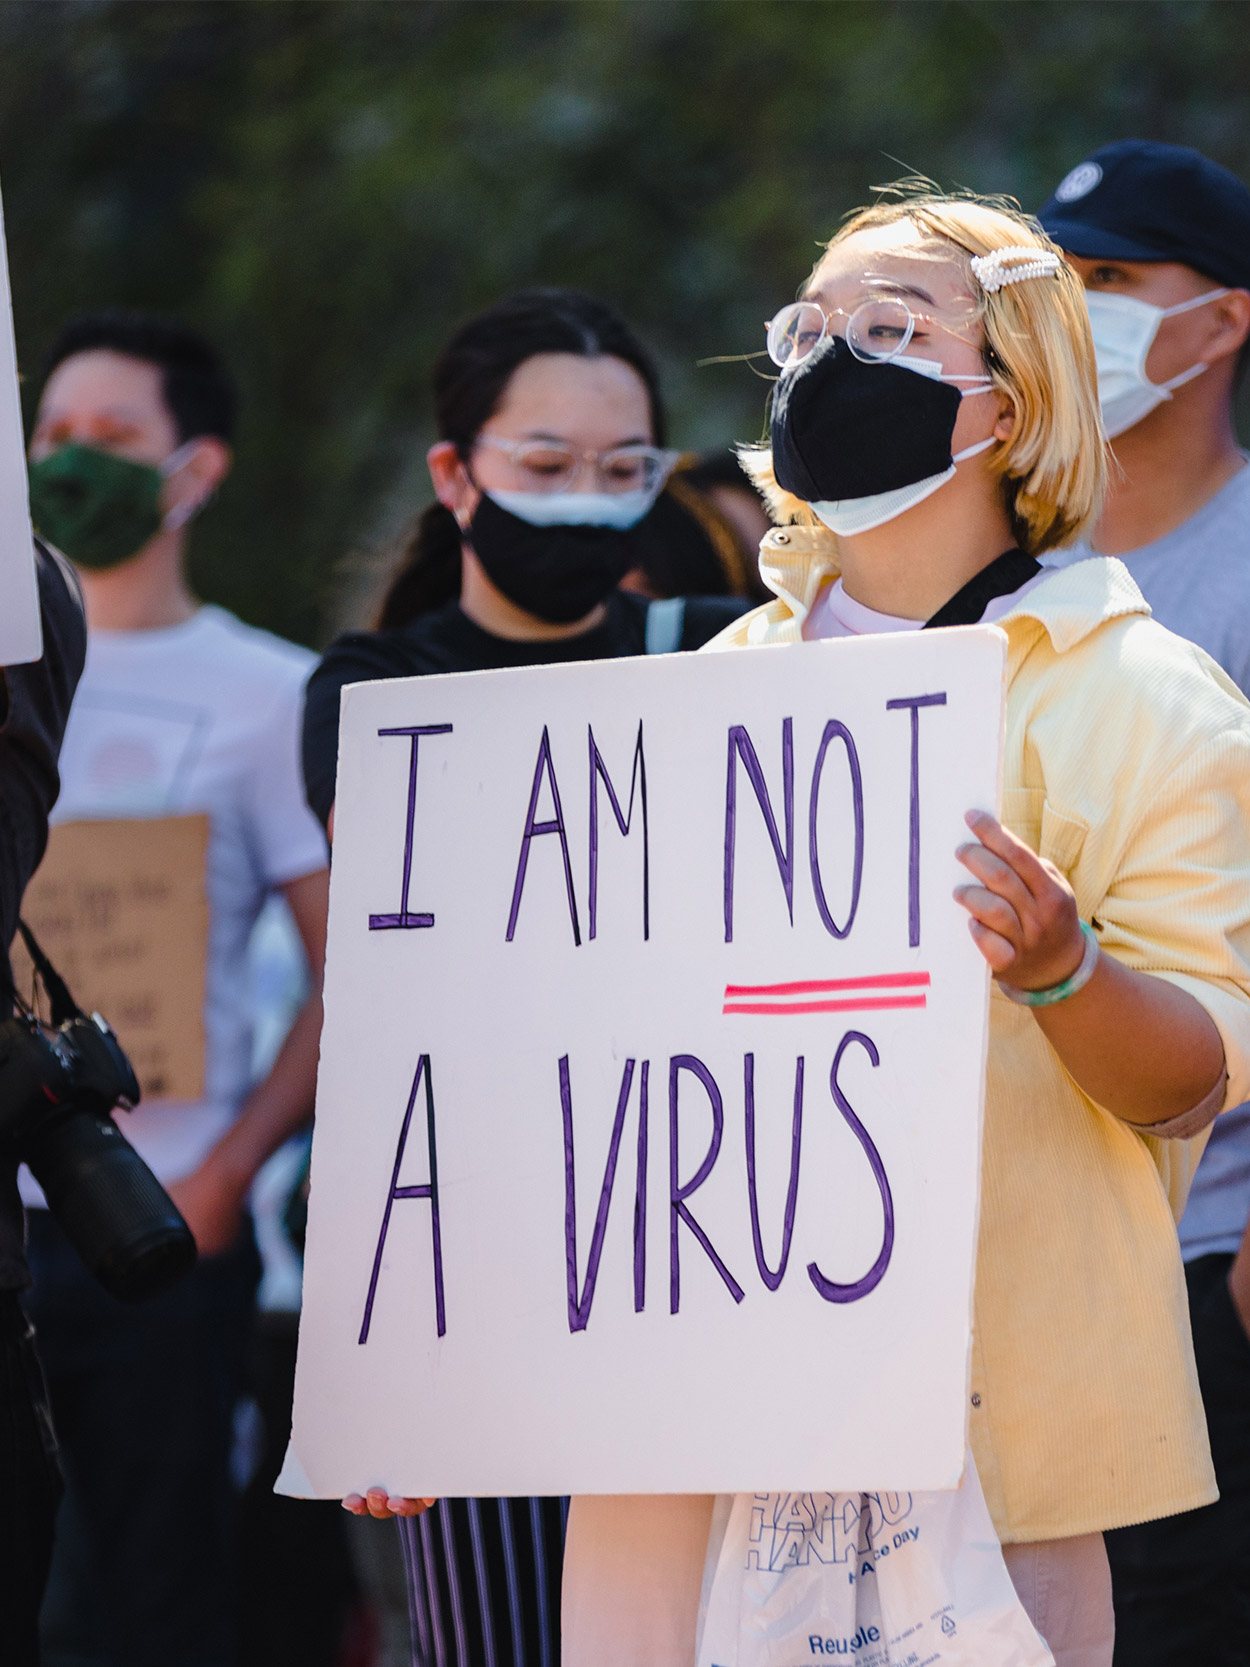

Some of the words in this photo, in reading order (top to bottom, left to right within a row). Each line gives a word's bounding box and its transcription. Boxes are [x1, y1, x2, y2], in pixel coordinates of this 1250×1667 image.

[367, 722, 453, 930] I
[505, 718, 649, 947] AM
[724, 691, 947, 948] NOT
[359, 1053, 446, 1345] A
[558, 1030, 894, 1334] VIRUS
[893, 1526, 919, 1549] Day
